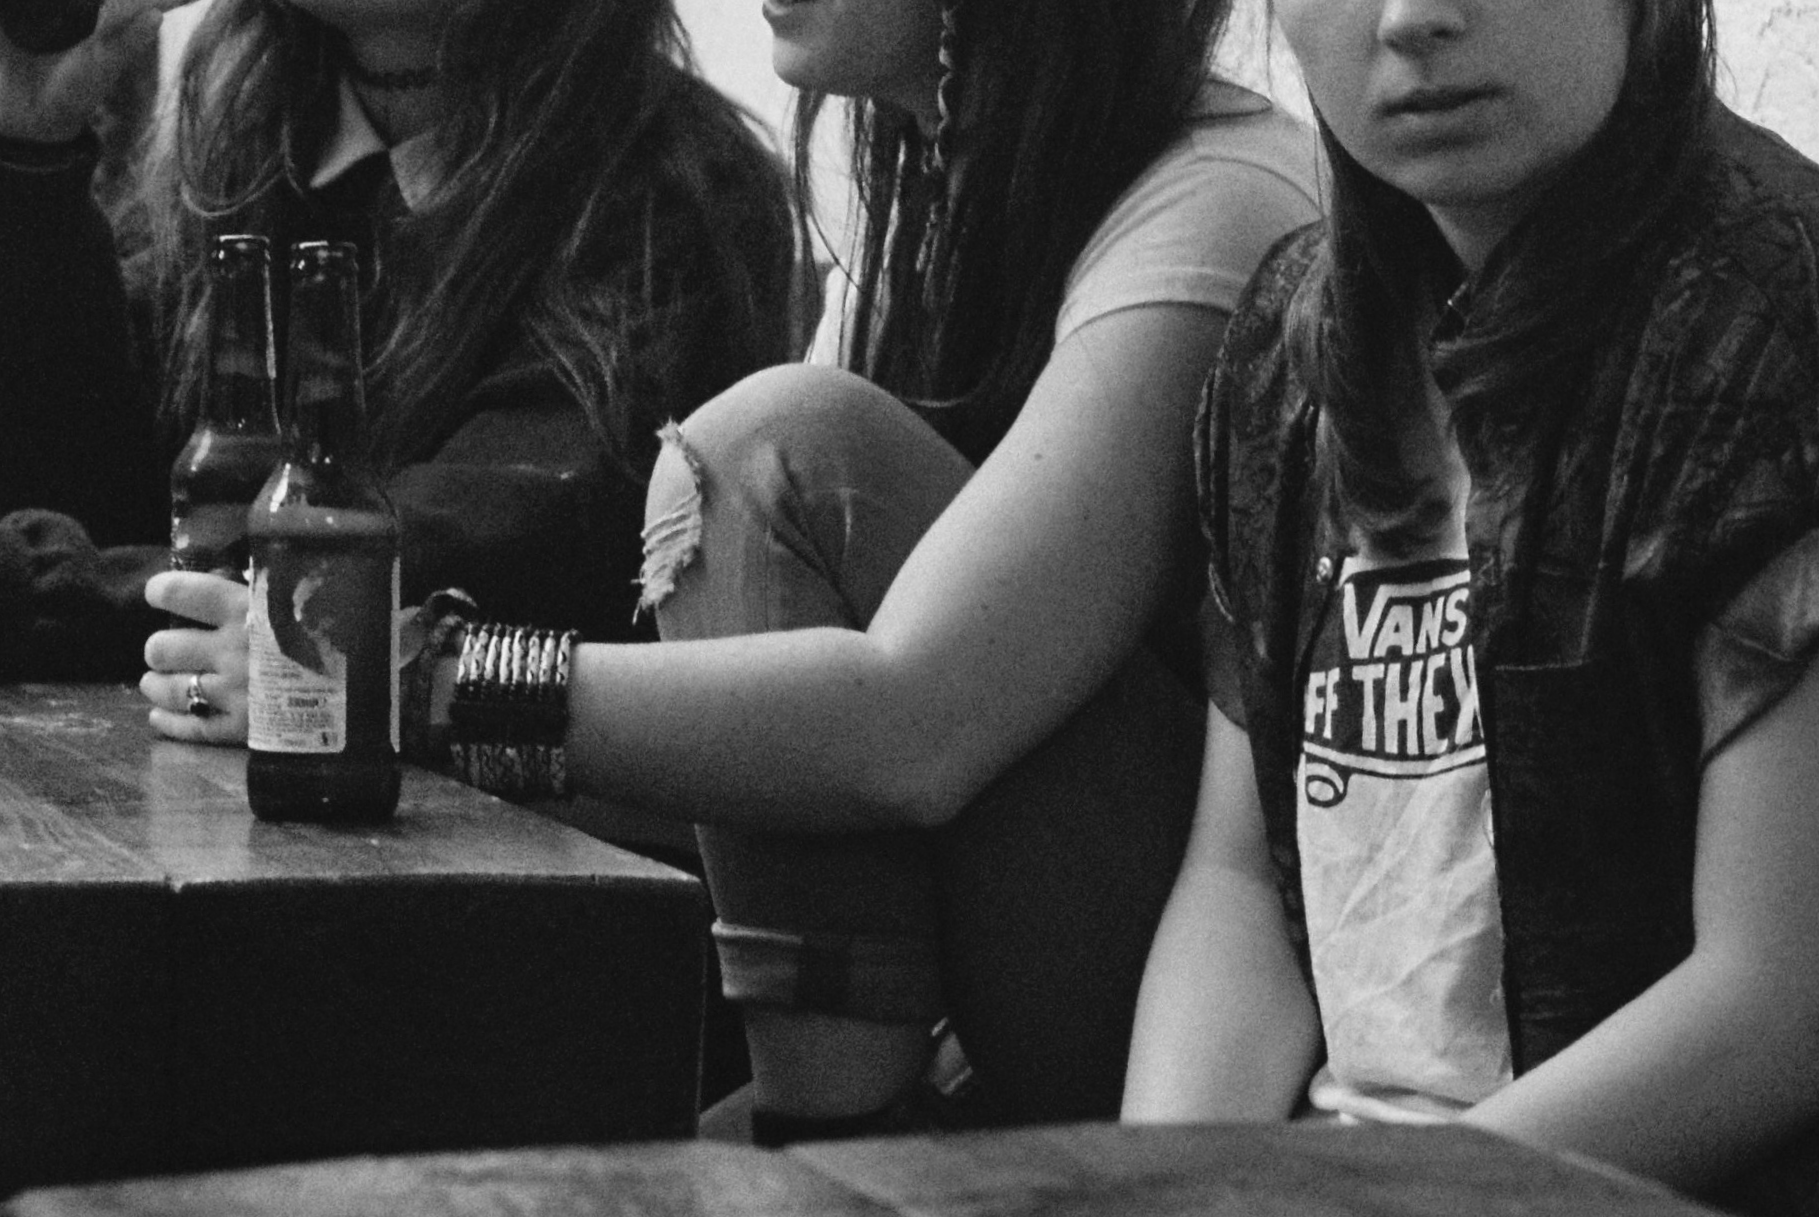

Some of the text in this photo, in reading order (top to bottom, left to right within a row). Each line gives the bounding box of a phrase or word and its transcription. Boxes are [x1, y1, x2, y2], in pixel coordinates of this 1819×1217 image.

[1342, 581, 1470, 660] VANS
[1303, 666, 1341, 740] FF
[1350, 651, 1449, 757] THE
